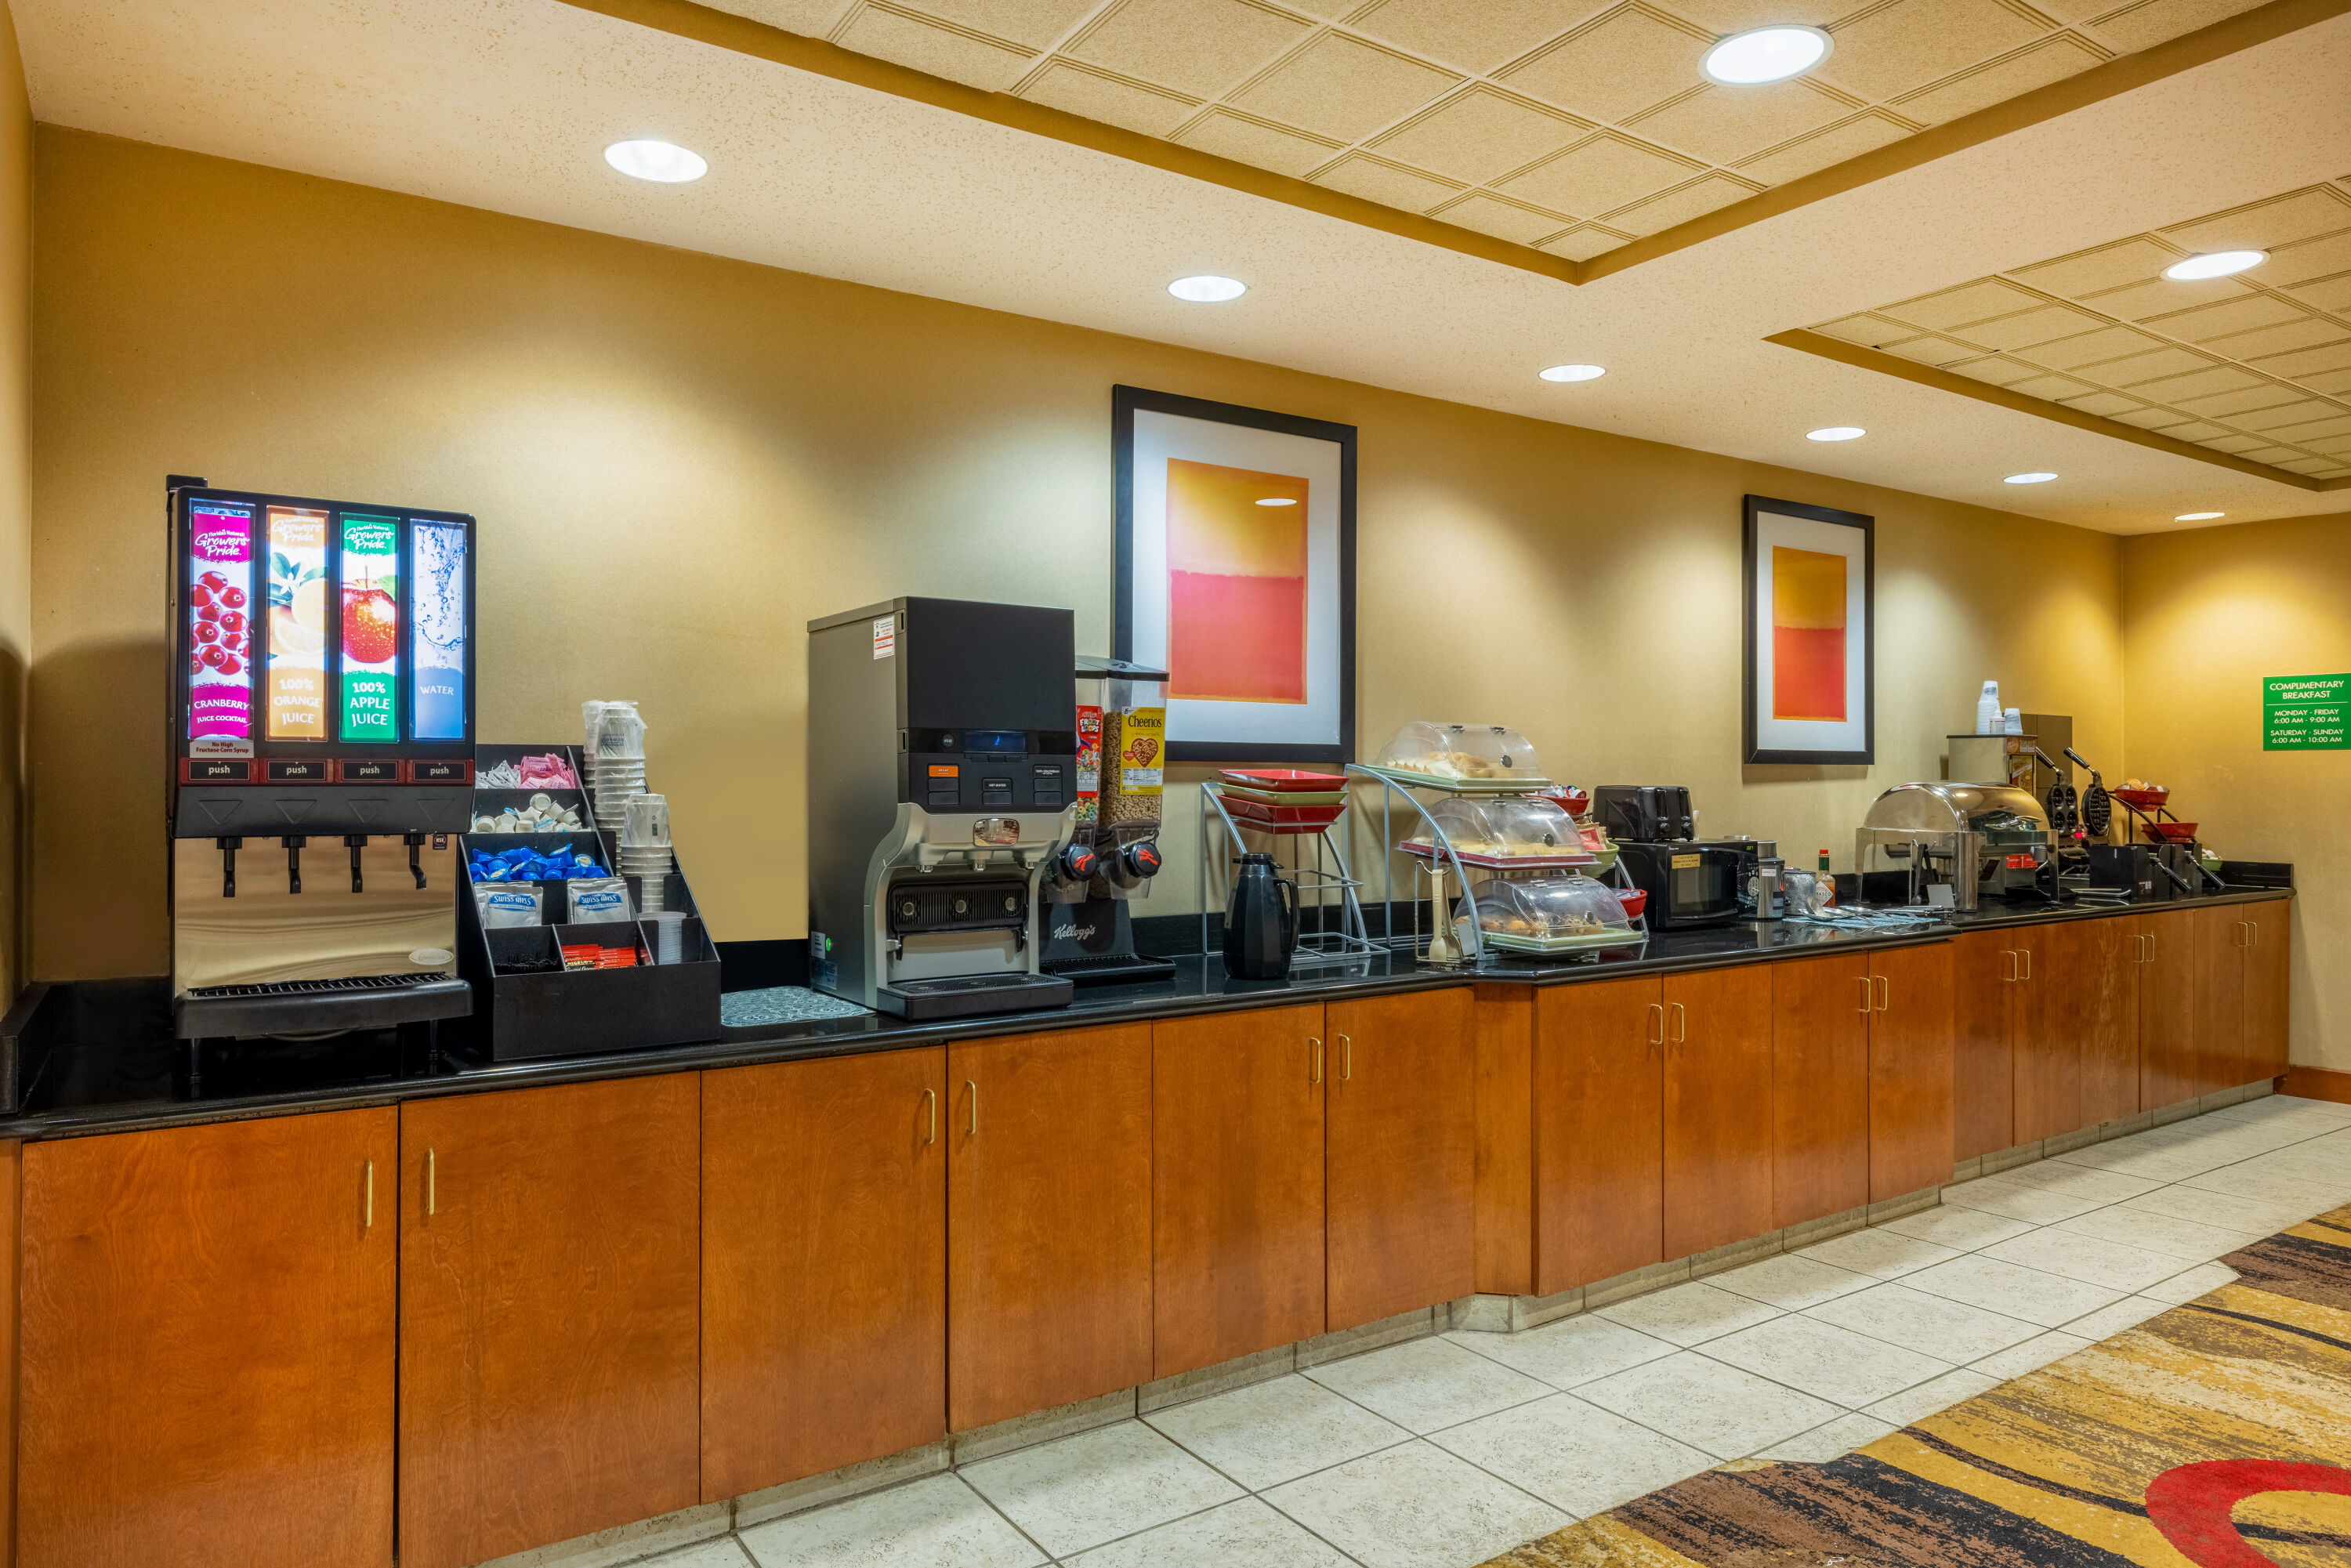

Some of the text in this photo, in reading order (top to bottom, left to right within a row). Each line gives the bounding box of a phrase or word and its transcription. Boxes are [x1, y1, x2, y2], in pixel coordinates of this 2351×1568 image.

[279, 678, 314, 691] 100%
[353, 682, 386, 694] 100%
[420, 685, 455, 696] WATER
[2269, 680, 2345, 691] COMPLIMENTARY
[2282, 690, 2331, 700] BREAKFAST
[194, 699, 250, 711] CRANBERRY
[273, 695, 321, 708] ORANGE
[350, 697, 390, 710] APPLE
[197, 715, 248, 724] JUICE COCKTAIL
[282, 712, 315, 726] JUICE
[351, 713, 389, 727] JUICE
[1128, 715, 1161, 727] Cheerios
[208, 765, 230, 776] push
[286, 766, 307, 776] push
[360, 766, 379, 776] push
[429, 766, 449, 776] push
[1053, 923, 1096, 940] Kellogg's
